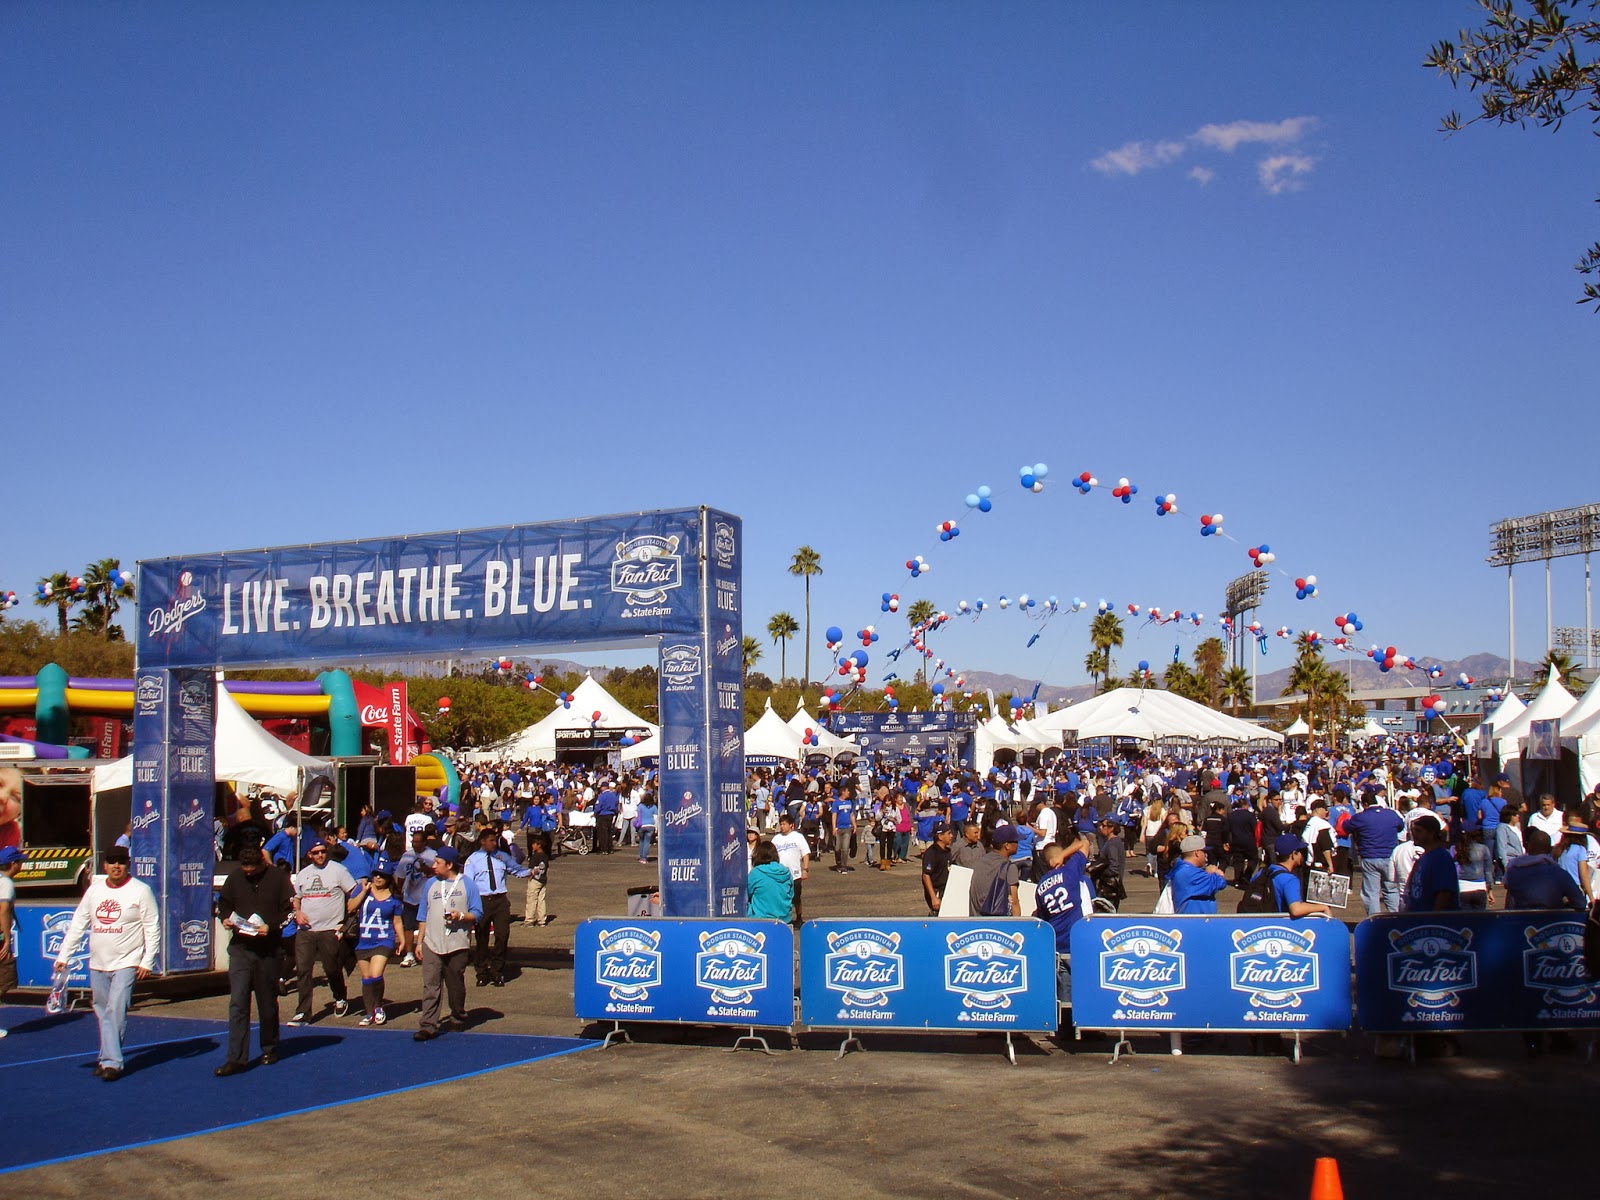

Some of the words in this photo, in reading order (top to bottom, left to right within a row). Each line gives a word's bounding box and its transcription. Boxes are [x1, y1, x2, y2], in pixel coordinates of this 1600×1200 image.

[646, 539, 672, 550] STADIUM
[618, 562, 675, 585] FanFest
[222, 578, 300, 634] LIVE.
[309, 564, 474, 629] BREATHE.
[484, 554, 592, 617] BLUE.
[718, 590, 738, 612] BLUE.
[148, 590, 206, 637] Dodgers
[632, 606, 671, 618] StateFarm
[716, 635, 738, 656] Dodgers
[664, 660, 698, 673] FanFest
[719, 691, 739, 710] BLUE.
[392, 688, 402, 745] StateFarm
[102, 721, 112, 759] teFarm
[676, 744, 700, 752] BREATHE.
[180, 757, 206, 772] BLUE.
[668, 754, 699, 770] BLUE.
[133, 809, 160, 829] Dodgers
[179, 807, 205, 828] Dodgers
[664, 802, 702, 826] Dodgers
[776, 842, 797, 852] Dodgers
[35, 861, 68, 869] THEATER
[137, 864, 156, 876] BLUE.
[183, 871, 204, 886] BLUE.
[672, 867, 698, 881] BLUE.
[1038, 873, 1063, 896] KERSHAW
[1044, 887, 1074, 914] 22
[360, 896, 389, 938] LA
[184, 933, 207, 944] FanFest
[606, 932, 628, 945] DODGER
[630, 932, 653, 945] STADIUM
[706, 933, 730, 946] DODGER
[733, 933, 758, 947] STADIUM
[836, 934, 862, 948] DODGER
[864, 933, 892, 948] STADIUM
[956, 934, 983, 948] DODGER
[986, 934, 1015, 949] STADIUM
[1111, 931, 1140, 945] DODGER
[1142, 931, 1172, 946] STADIUM
[1242, 931, 1271, 946] DODGER
[1274, 931, 1305, 946] STADIUM
[602, 957, 655, 977] FanFest
[703, 959, 760, 980] FanFest
[833, 960, 896, 982] FanFest
[952, 961, 1019, 984] FanFest
[1108, 958, 1177, 981] FanFest
[1239, 959, 1310, 982] FanFest
[1397, 958, 1469, 982] FanFest
[1532, 955, 1586, 980] FanFe
[617, 1003, 652, 1013] StateFarm
[719, 1006, 756, 1016] StateFarm
[850, 1010, 892, 1019] StateFarm
[1127, 1010, 1172, 1019] StateFarm
[971, 1012, 1015, 1021] StateFarm
[1258, 1011, 1305, 1021] StateFarm
[1416, 1012, 1464, 1022] StateFarm
